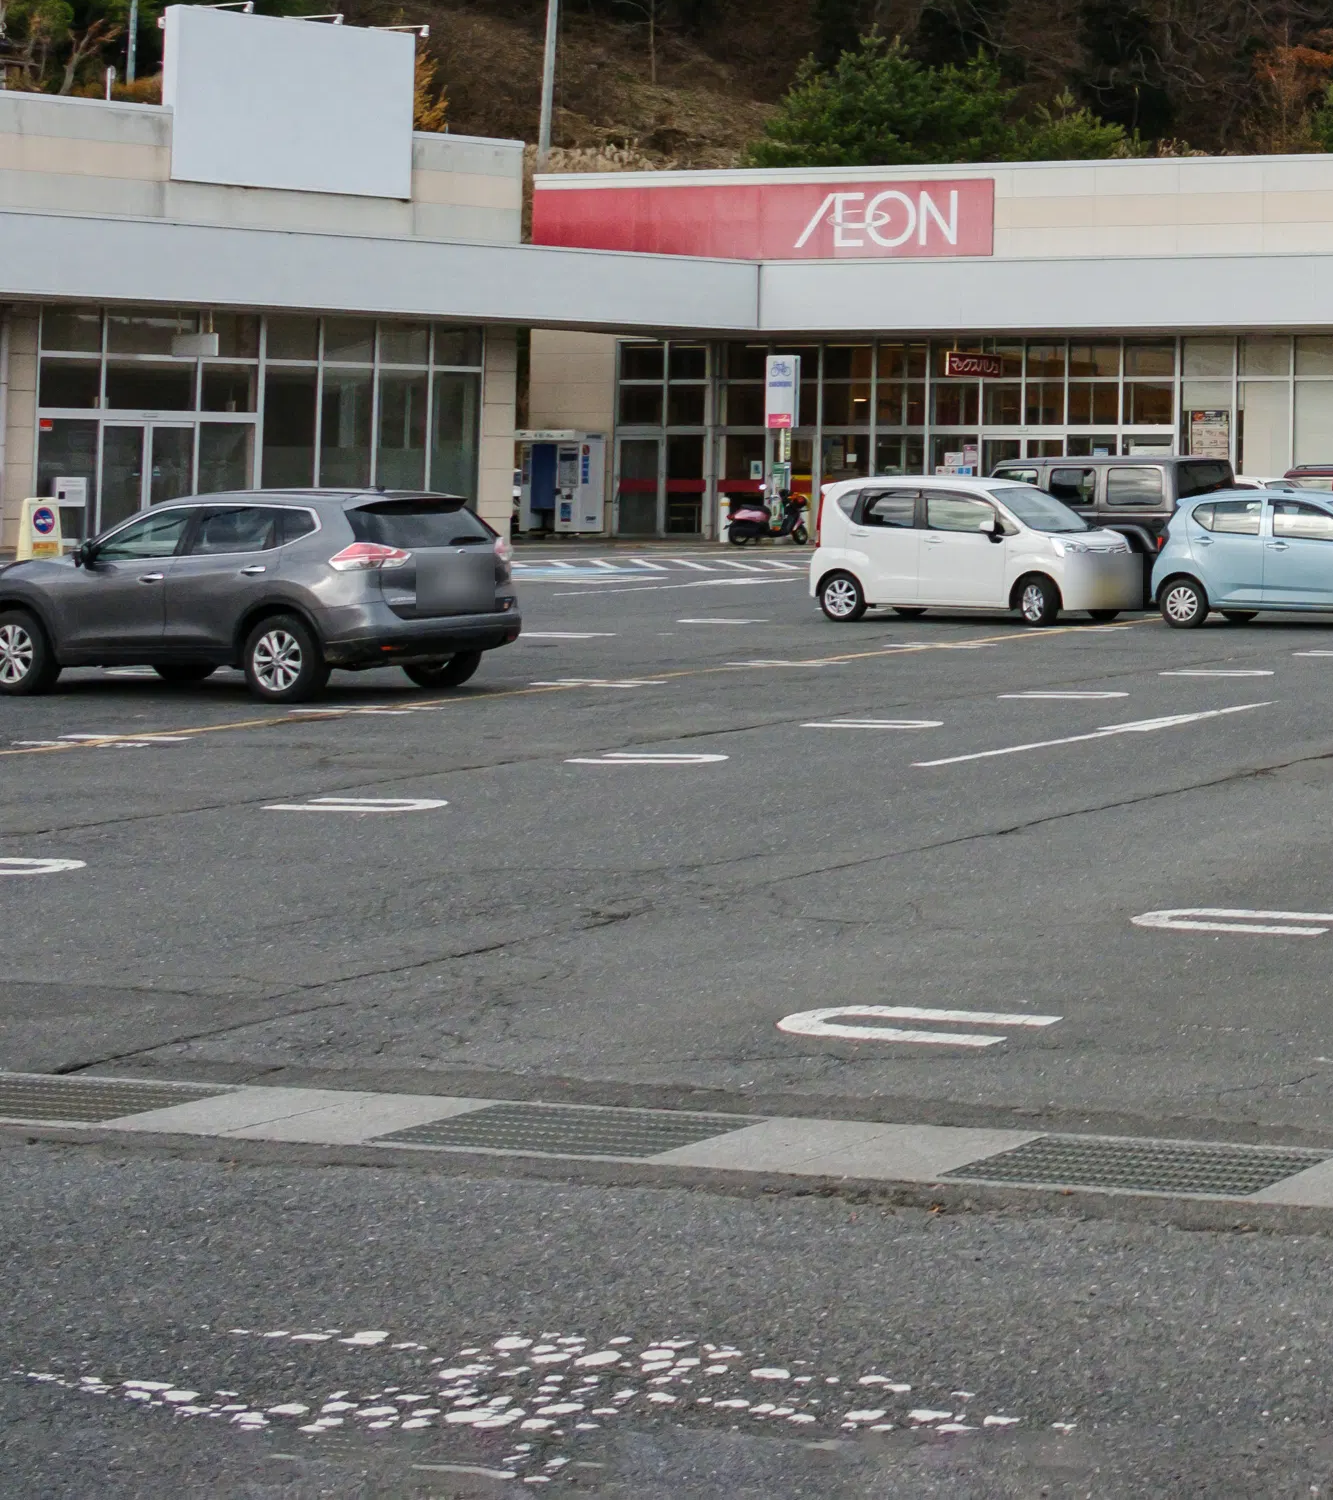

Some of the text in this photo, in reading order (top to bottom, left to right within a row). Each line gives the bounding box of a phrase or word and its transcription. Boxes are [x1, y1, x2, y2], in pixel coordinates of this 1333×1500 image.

[950, 357, 999, 374] マックスバリュ
